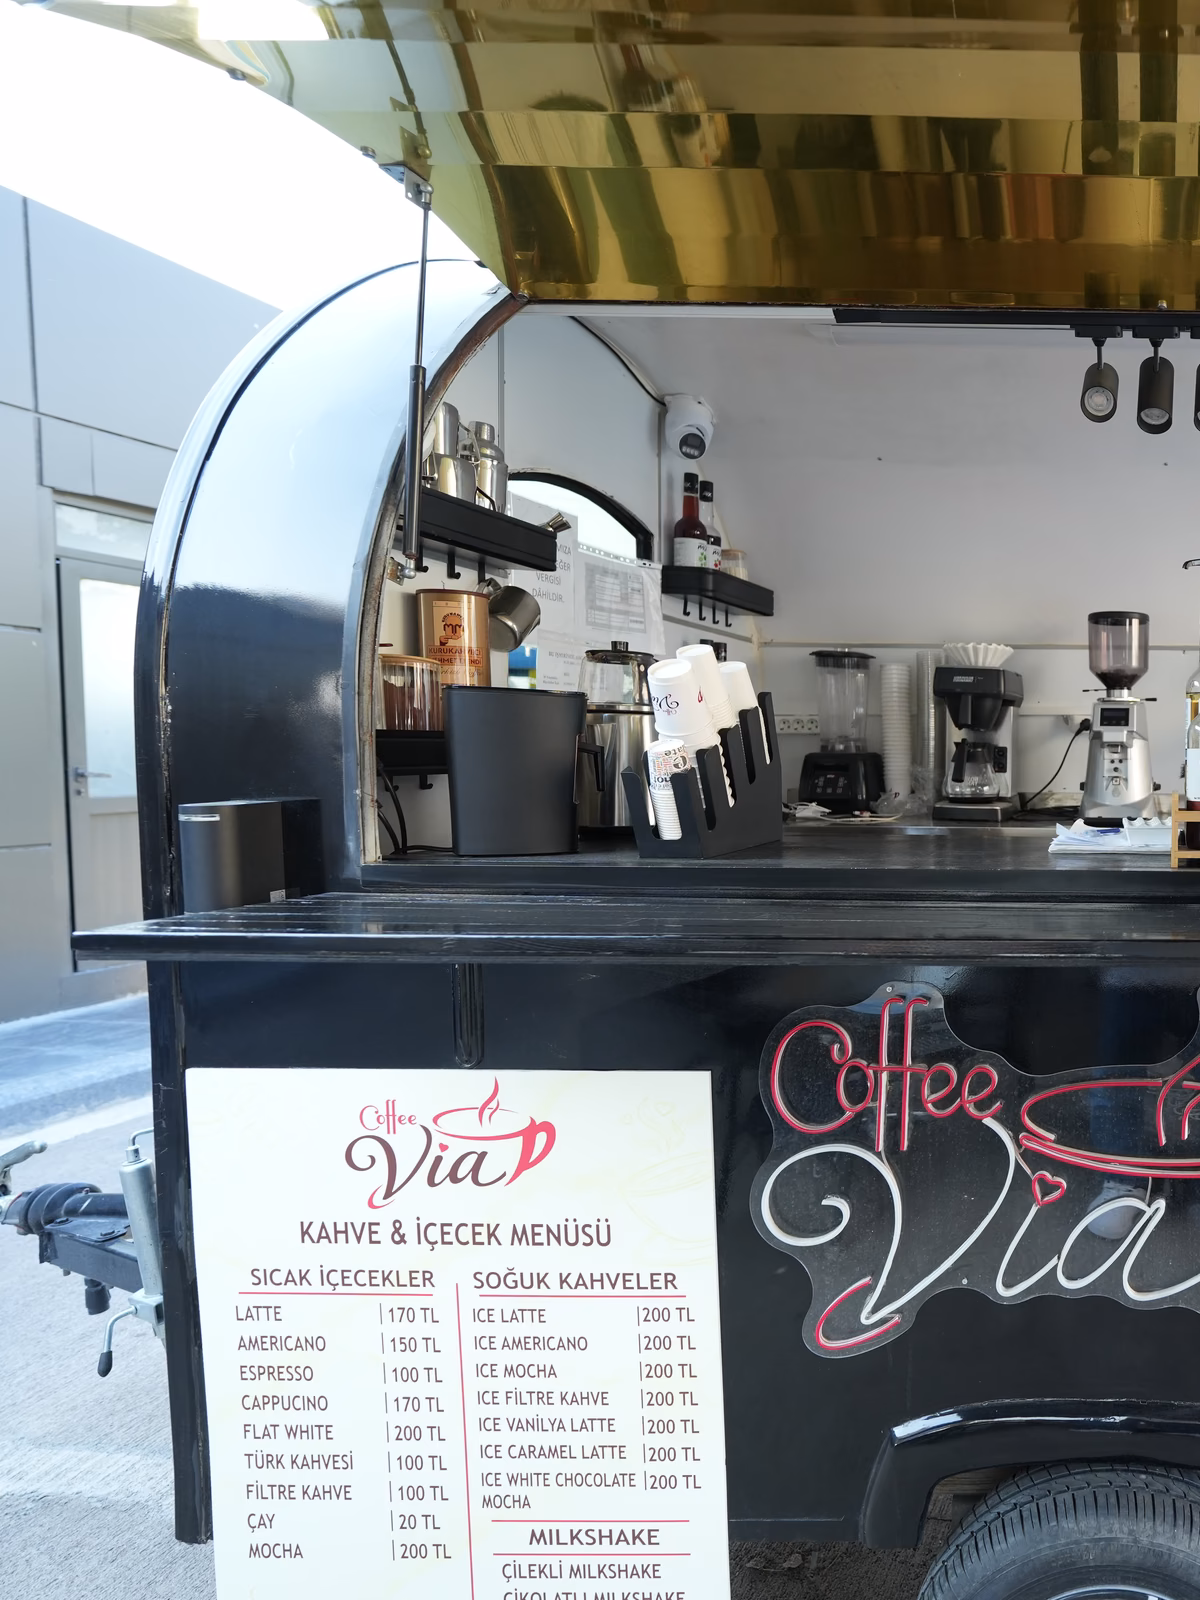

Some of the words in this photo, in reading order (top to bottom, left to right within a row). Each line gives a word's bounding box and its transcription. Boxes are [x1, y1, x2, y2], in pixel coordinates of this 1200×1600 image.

[556, 559, 571, 573] ĞER
[771, 997, 1003, 1152] Coffee
[359, 1098, 418, 1135] Coffee
[344, 1123, 507, 1201] Via
[300, 1221, 382, 1245] KAHVE
[390, 1219, 408, 1246] &
[415, 1216, 503, 1252] İÇECEK
[510, 1217, 612, 1247] MENÜSÜ
[250, 1268, 312, 1287] SICAK
[319, 1264, 436, 1292] İÇECEKLER
[472, 1266, 551, 1290] SOĞUK
[558, 1272, 679, 1290] KAHVELER
[235, 1305, 283, 1322] LATTE
[388, 1306, 416, 1323] 170
[419, 1307, 440, 1324] TL
[472, 1307, 496, 1323] ICE
[500, 1308, 547, 1324] LATTE
[642, 1307, 671, 1323] 200
[675, 1307, 696, 1322] TL
[237, 1335, 326, 1352] AMERICANO
[390, 1336, 418, 1353] 150
[421, 1337, 442, 1353] TL
[474, 1335, 497, 1351] ICE
[501, 1335, 588, 1351] AMERICANO
[643, 1335, 672, 1351] 200
[676, 1335, 697, 1351] TL
[239, 1365, 314, 1382] ESPRESSO
[392, 1366, 419, 1383] 100
[423, 1367, 443, 1383] TL
[475, 1363, 499, 1378] ICE
[503, 1363, 558, 1379] MOCHA
[644, 1363, 673, 1379] 200
[677, 1363, 698, 1379] TL
[241, 1394, 329, 1412] CAPPUCINO
[393, 1396, 421, 1413] 170
[424, 1396, 445, 1413] TL
[477, 1390, 500, 1406] ICE
[505, 1386, 555, 1406] FİLTRE
[560, 1391, 610, 1406] KAHVE
[646, 1391, 675, 1407] 200
[678, 1391, 699, 1406] TL
[243, 1423, 280, 1440] FLAT
[284, 1424, 334, 1441] WHITE
[394, 1425, 422, 1442] 200
[426, 1425, 446, 1442] TL
[478, 1417, 502, 1432] ICE
[505, 1413, 567, 1432] VANİLYA
[570, 1417, 616, 1433] LATTE
[647, 1419, 676, 1435] 200
[679, 1419, 700, 1434] TL
[243, 1449, 286, 1470] TÜRK
[290, 1450, 354, 1471] KAHVESİ
[396, 1454, 424, 1471] 100
[427, 1455, 448, 1471] TL
[480, 1444, 503, 1459] ICE
[507, 1444, 577, 1460] CARAMEL
[581, 1444, 627, 1460] LATTE
[648, 1446, 677, 1462] 200
[680, 1446, 701, 1462] TL
[246, 1480, 297, 1501] FİLTRE
[301, 1484, 353, 1501] KAHVE
[398, 1485, 425, 1501] 100
[429, 1485, 449, 1501] TL
[481, 1472, 502, 1487] ICE
[506, 1472, 551, 1487] WHITE
[555, 1472, 637, 1488] CHOCOLATE
[649, 1474, 678, 1490] 200
[681, 1474, 702, 1490] TL
[481, 1494, 532, 1509] MOCHA
[247, 1513, 276, 1534] ÇAY
[398, 1513, 417, 1530] 20
[421, 1514, 441, 1530] TL
[528, 1528, 660, 1546] MILKSHAKE
[248, 1542, 304, 1559] MOCHA
[400, 1543, 428, 1560] 200
[432, 1543, 452, 1559] TL
[501, 1559, 563, 1584] ÇİLEKLİ
[568, 1563, 662, 1580] MILKSHAKE
